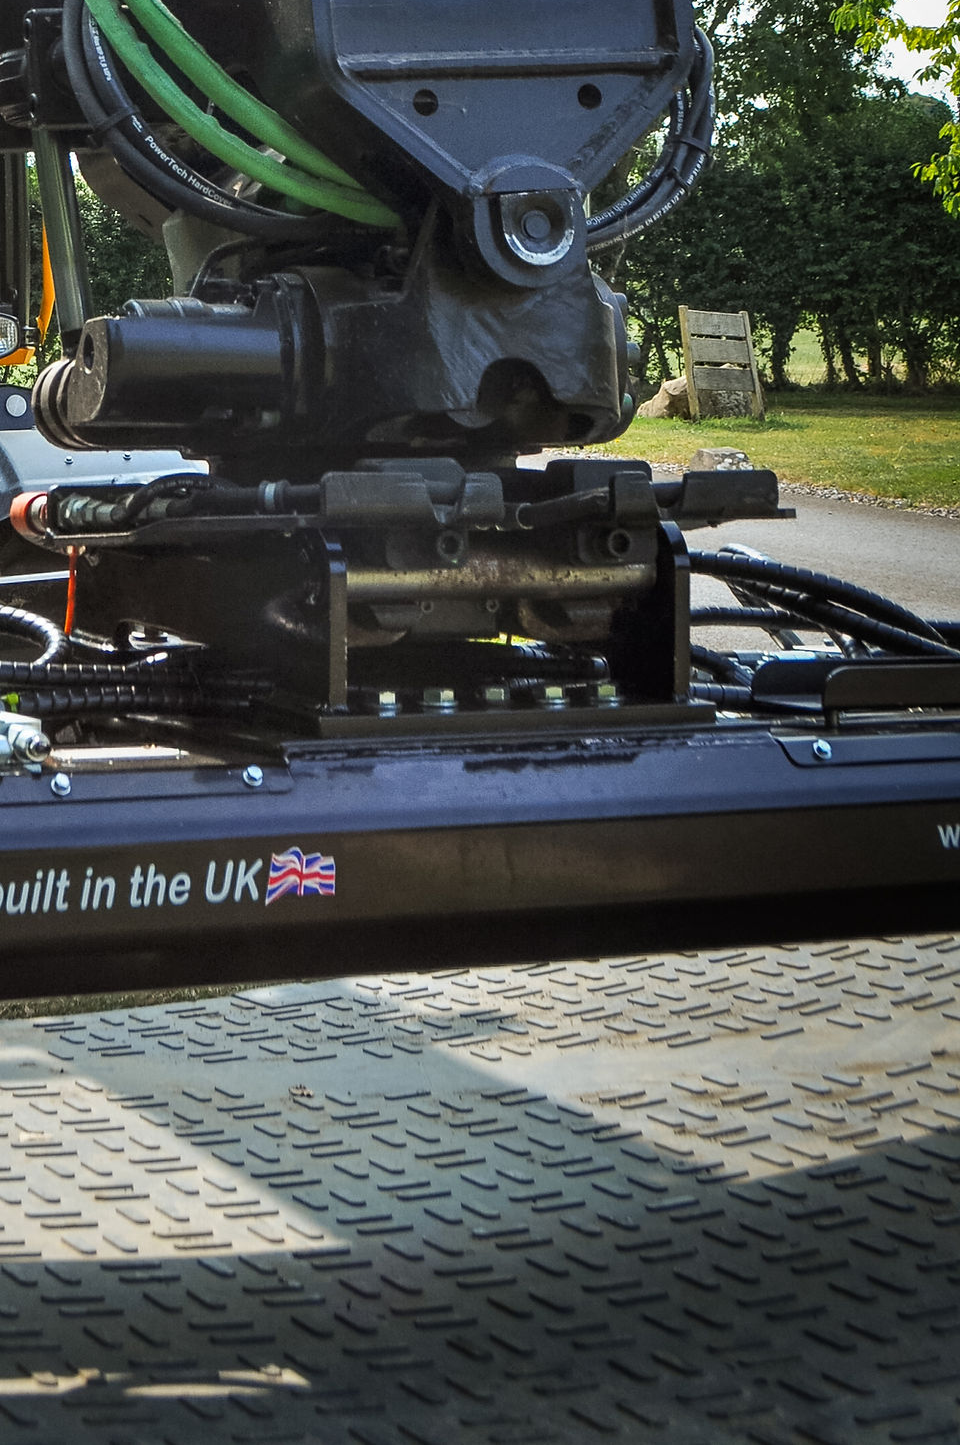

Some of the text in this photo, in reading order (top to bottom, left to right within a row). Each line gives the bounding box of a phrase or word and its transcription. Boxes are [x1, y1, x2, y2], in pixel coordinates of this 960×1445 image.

[145, 135, 233, 207] PowerTech HardCover
[585, 181, 652, 226] PowerTech HardCo
[81, 866, 116, 911] in
[130, 863, 191, 909] the
[205, 858, 263, 904] UK
